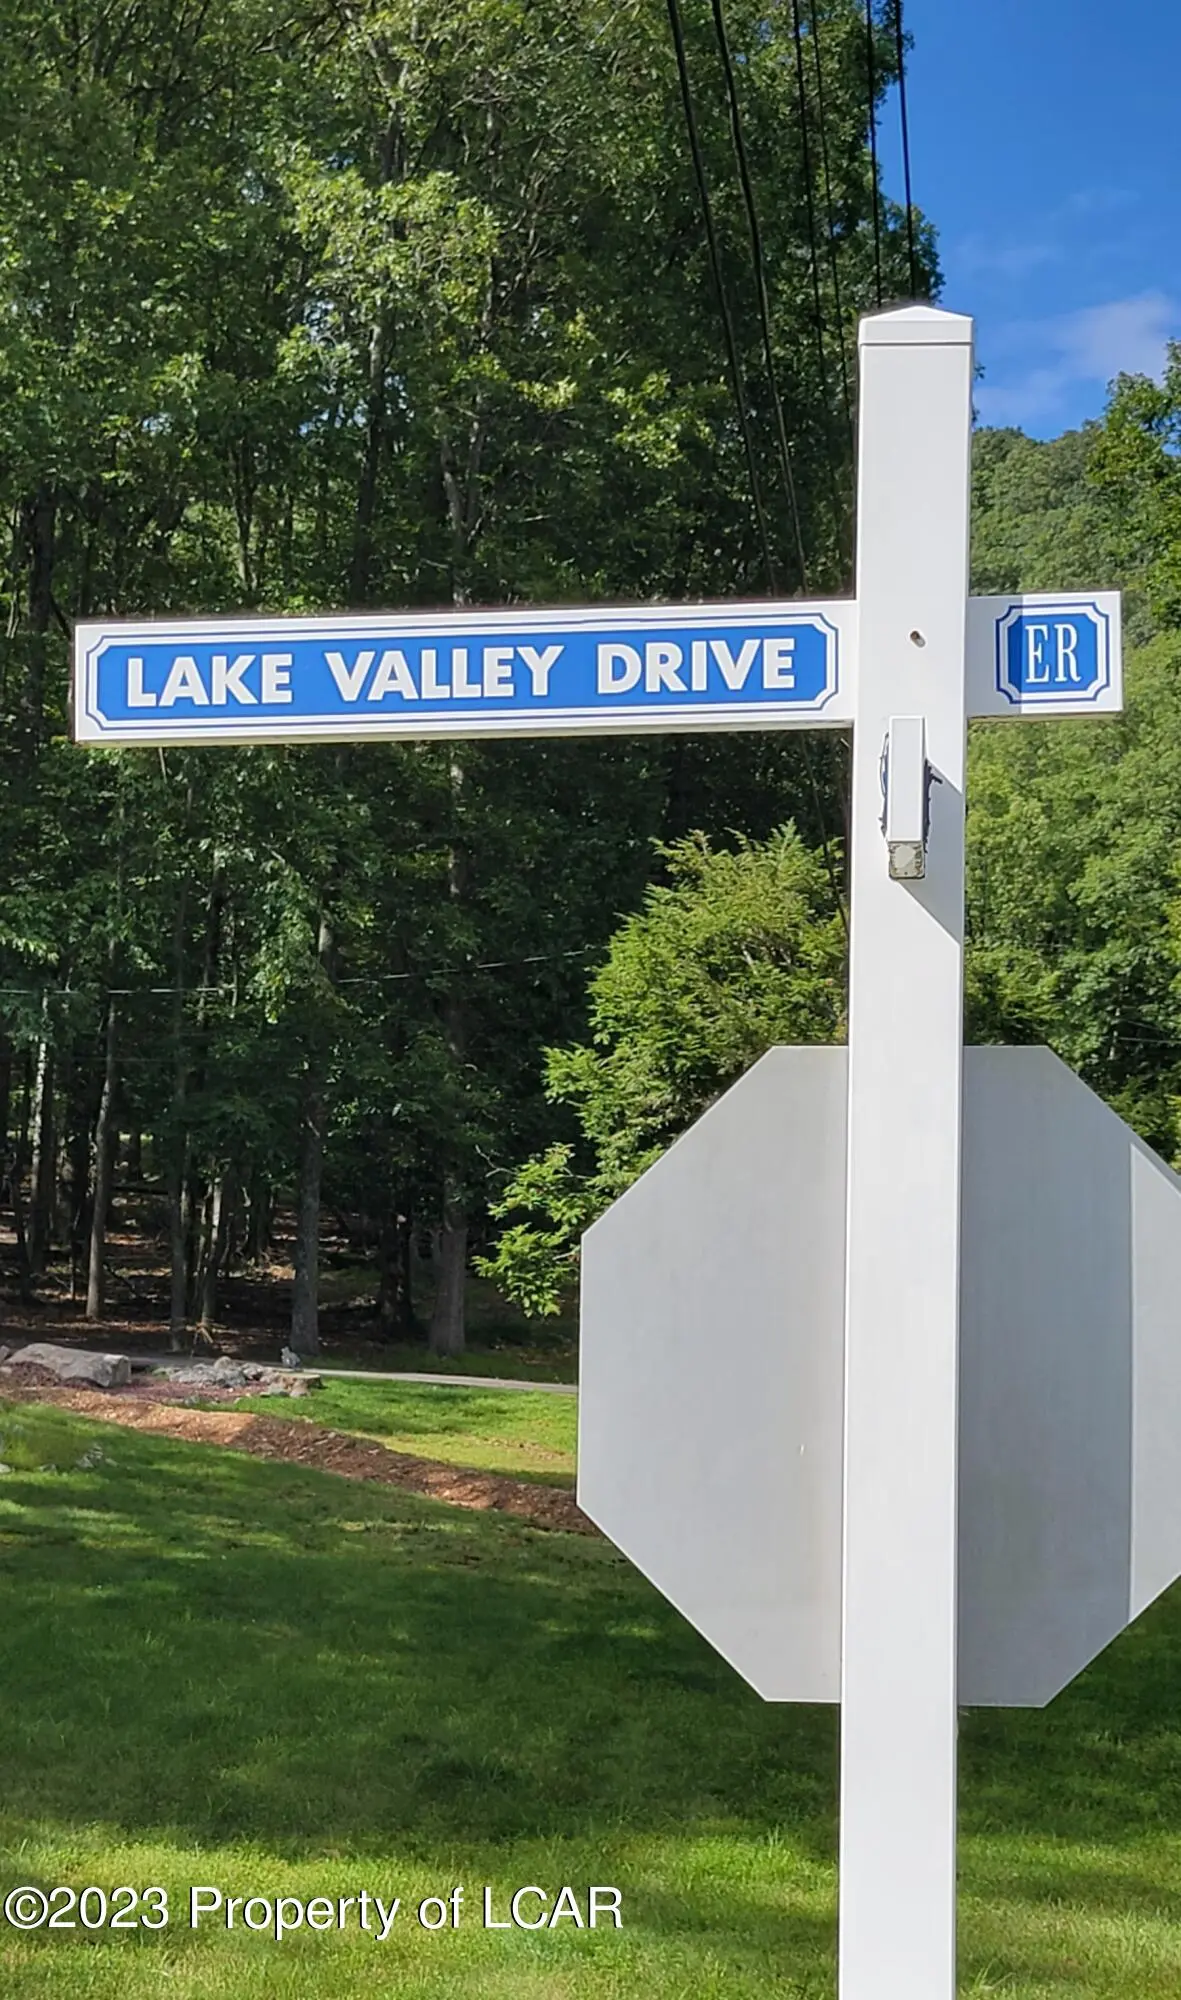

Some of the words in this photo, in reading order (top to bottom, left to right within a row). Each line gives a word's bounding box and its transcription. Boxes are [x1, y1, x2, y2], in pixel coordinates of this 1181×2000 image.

[126, 652, 293, 708] LAKE
[323, 645, 565, 702] VALLEY
[596, 637, 796, 695] DRIVE
[1024, 622, 1082, 684] ER
